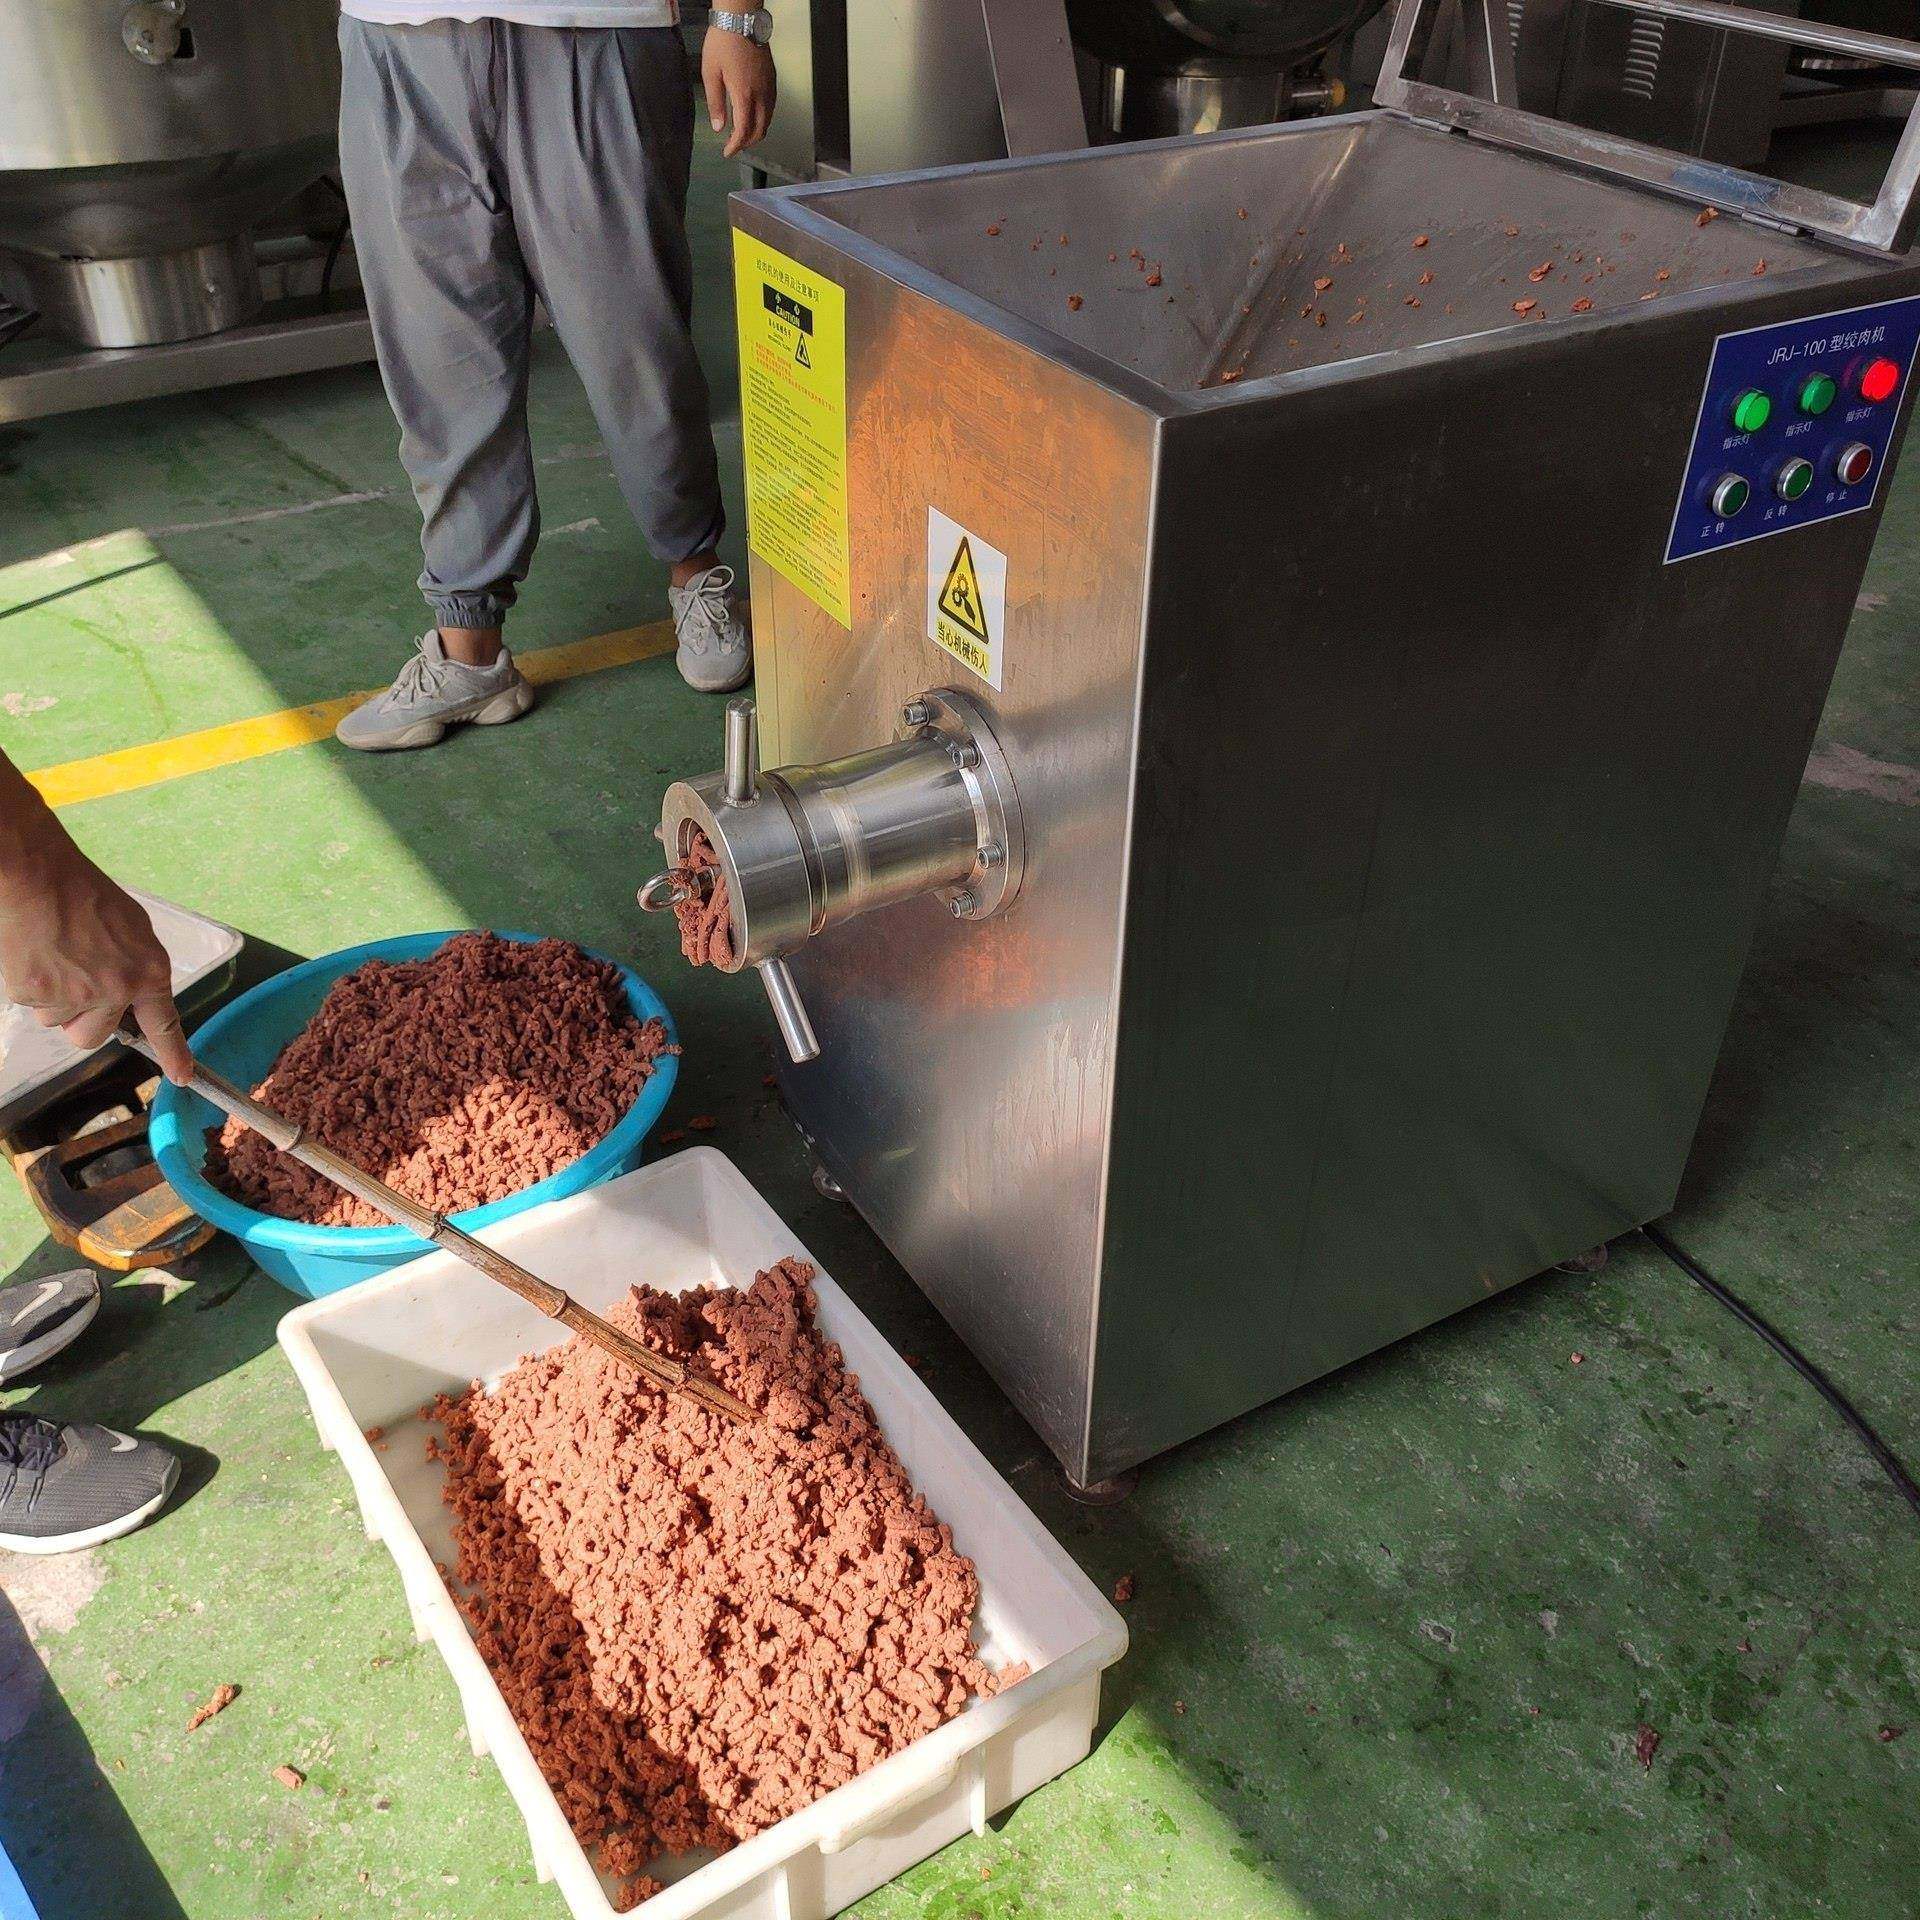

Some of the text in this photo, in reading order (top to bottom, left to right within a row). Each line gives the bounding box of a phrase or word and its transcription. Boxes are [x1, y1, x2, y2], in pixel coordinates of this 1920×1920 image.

[775, 305, 801, 327] CAUTION
[1767, 326, 1885, 366] JRJ-100 型绞肉机
[1845, 406, 1873, 423] 指示灯
[1785, 421, 1813, 437] 指示灯
[1722, 433, 1751, 450] 指示灯
[937, 621, 988, 674] 当心机械伤人
